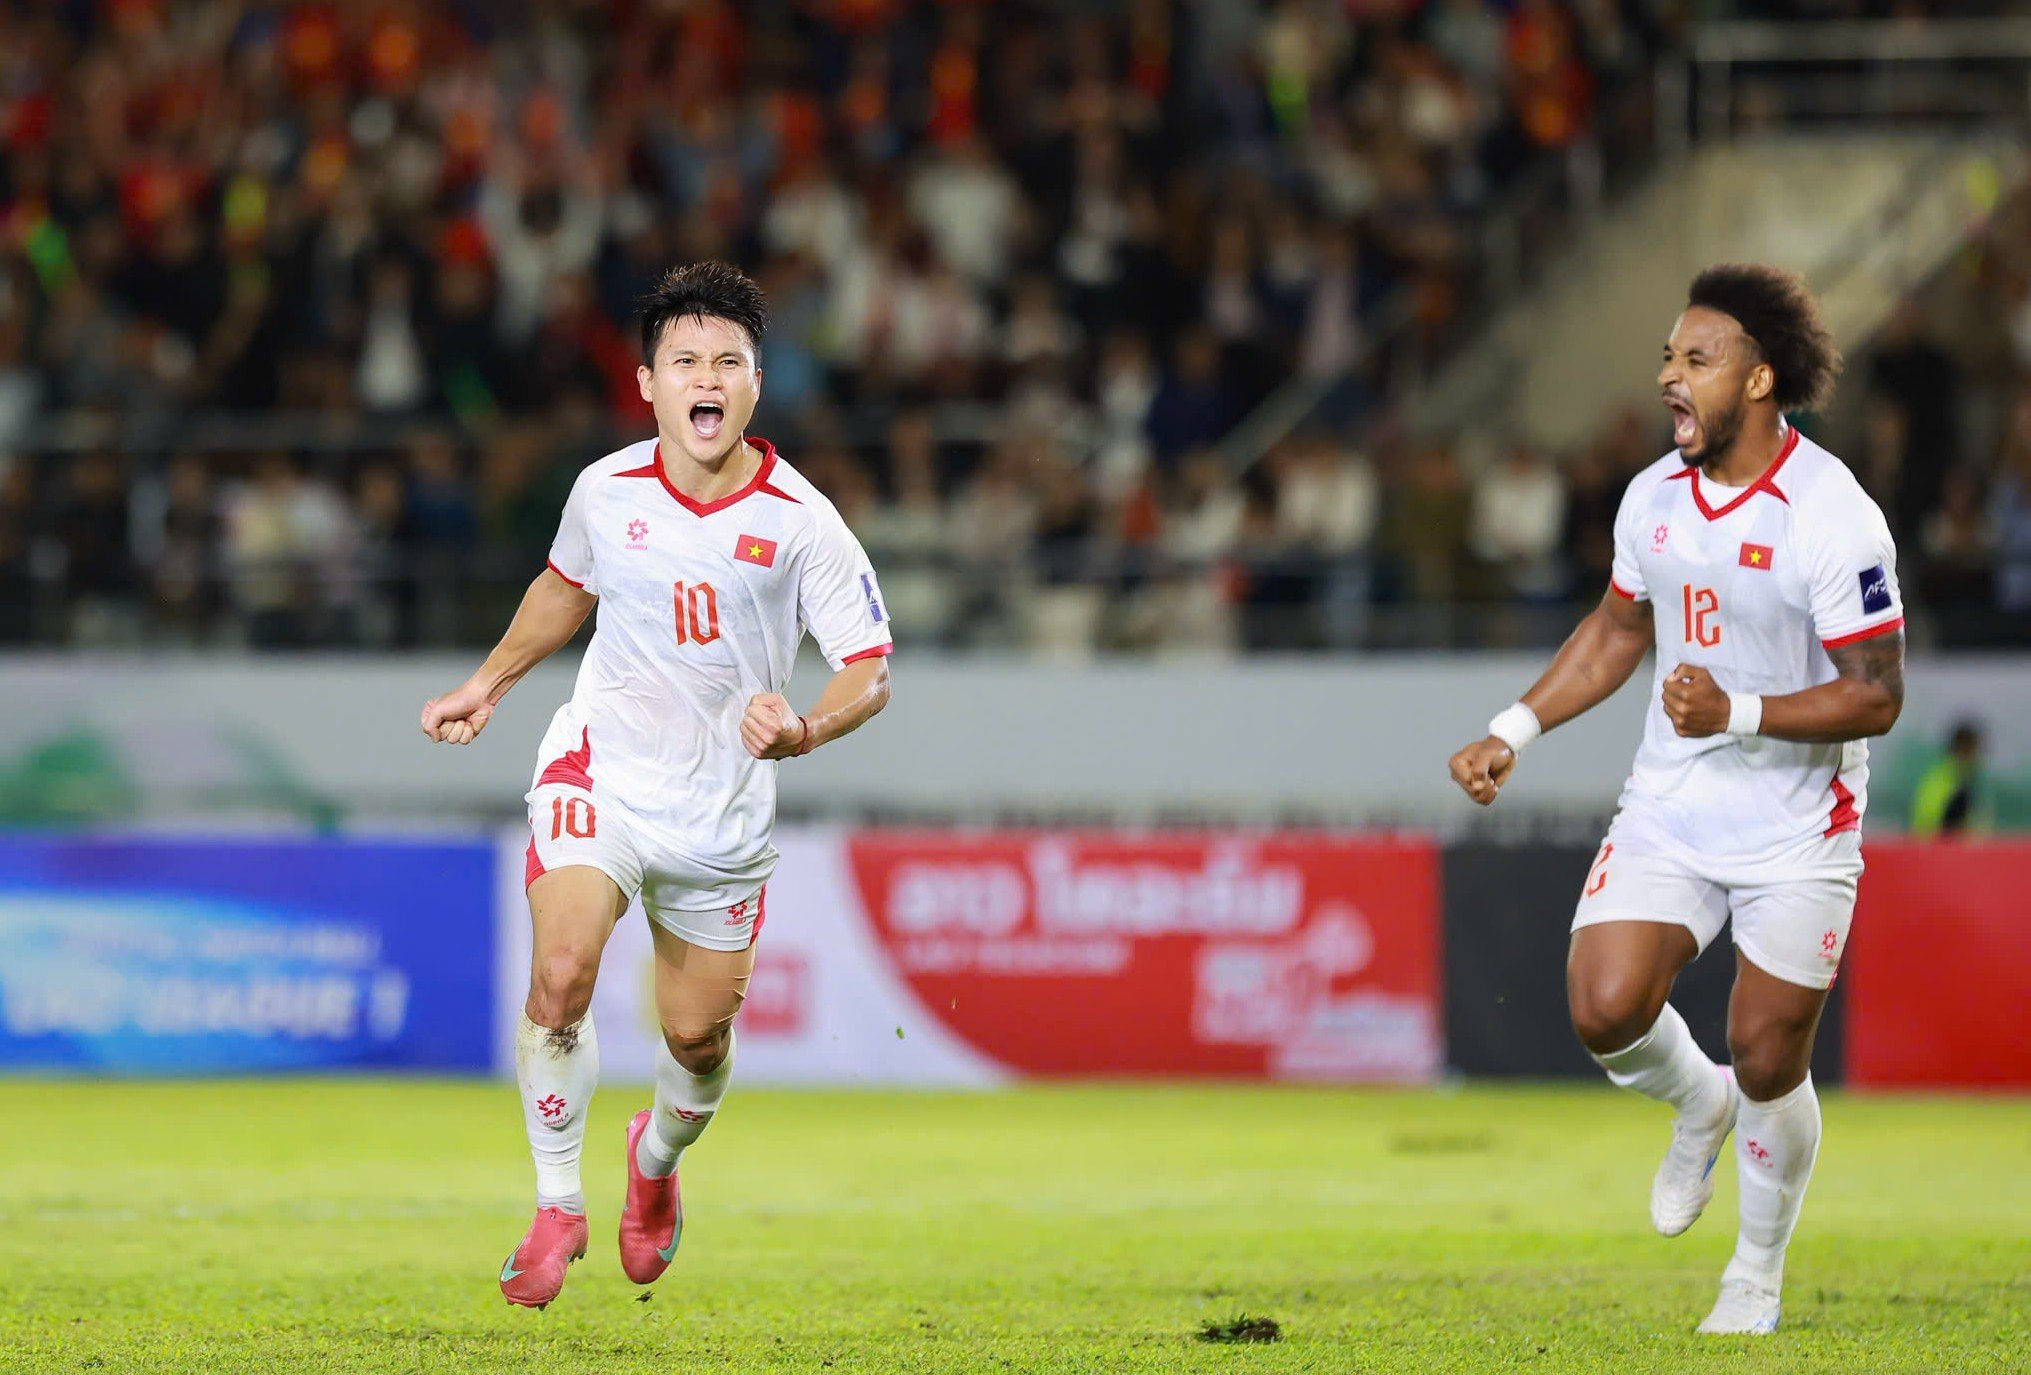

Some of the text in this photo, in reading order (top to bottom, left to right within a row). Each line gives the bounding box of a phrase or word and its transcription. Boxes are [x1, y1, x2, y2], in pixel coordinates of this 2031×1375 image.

[674, 580, 721, 646] 10
[1683, 583, 1720, 647] 12
[1864, 578, 1887, 601] AFC
[551, 796, 596, 841] 10
